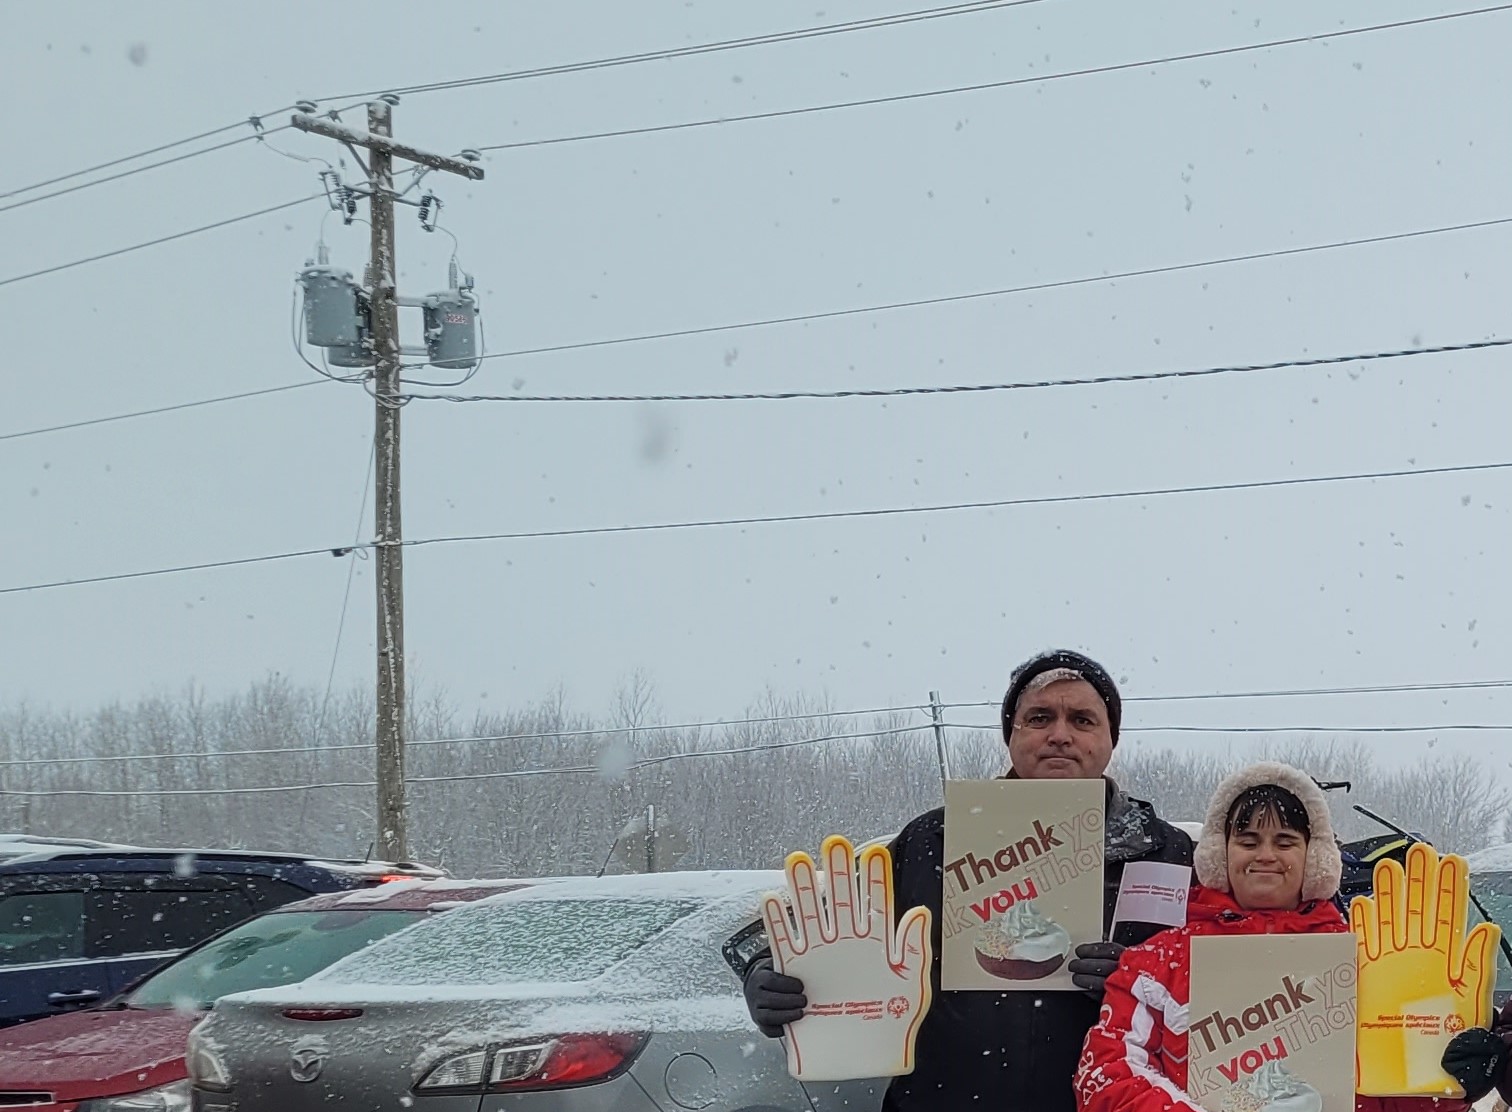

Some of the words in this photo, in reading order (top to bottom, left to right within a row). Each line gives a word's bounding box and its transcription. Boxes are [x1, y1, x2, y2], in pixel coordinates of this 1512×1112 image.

[945, 820, 1064, 892] Thank
[970, 877, 1038, 923] you
[1190, 976, 1315, 1053] Thank
[1216, 1036, 1288, 1084] you
